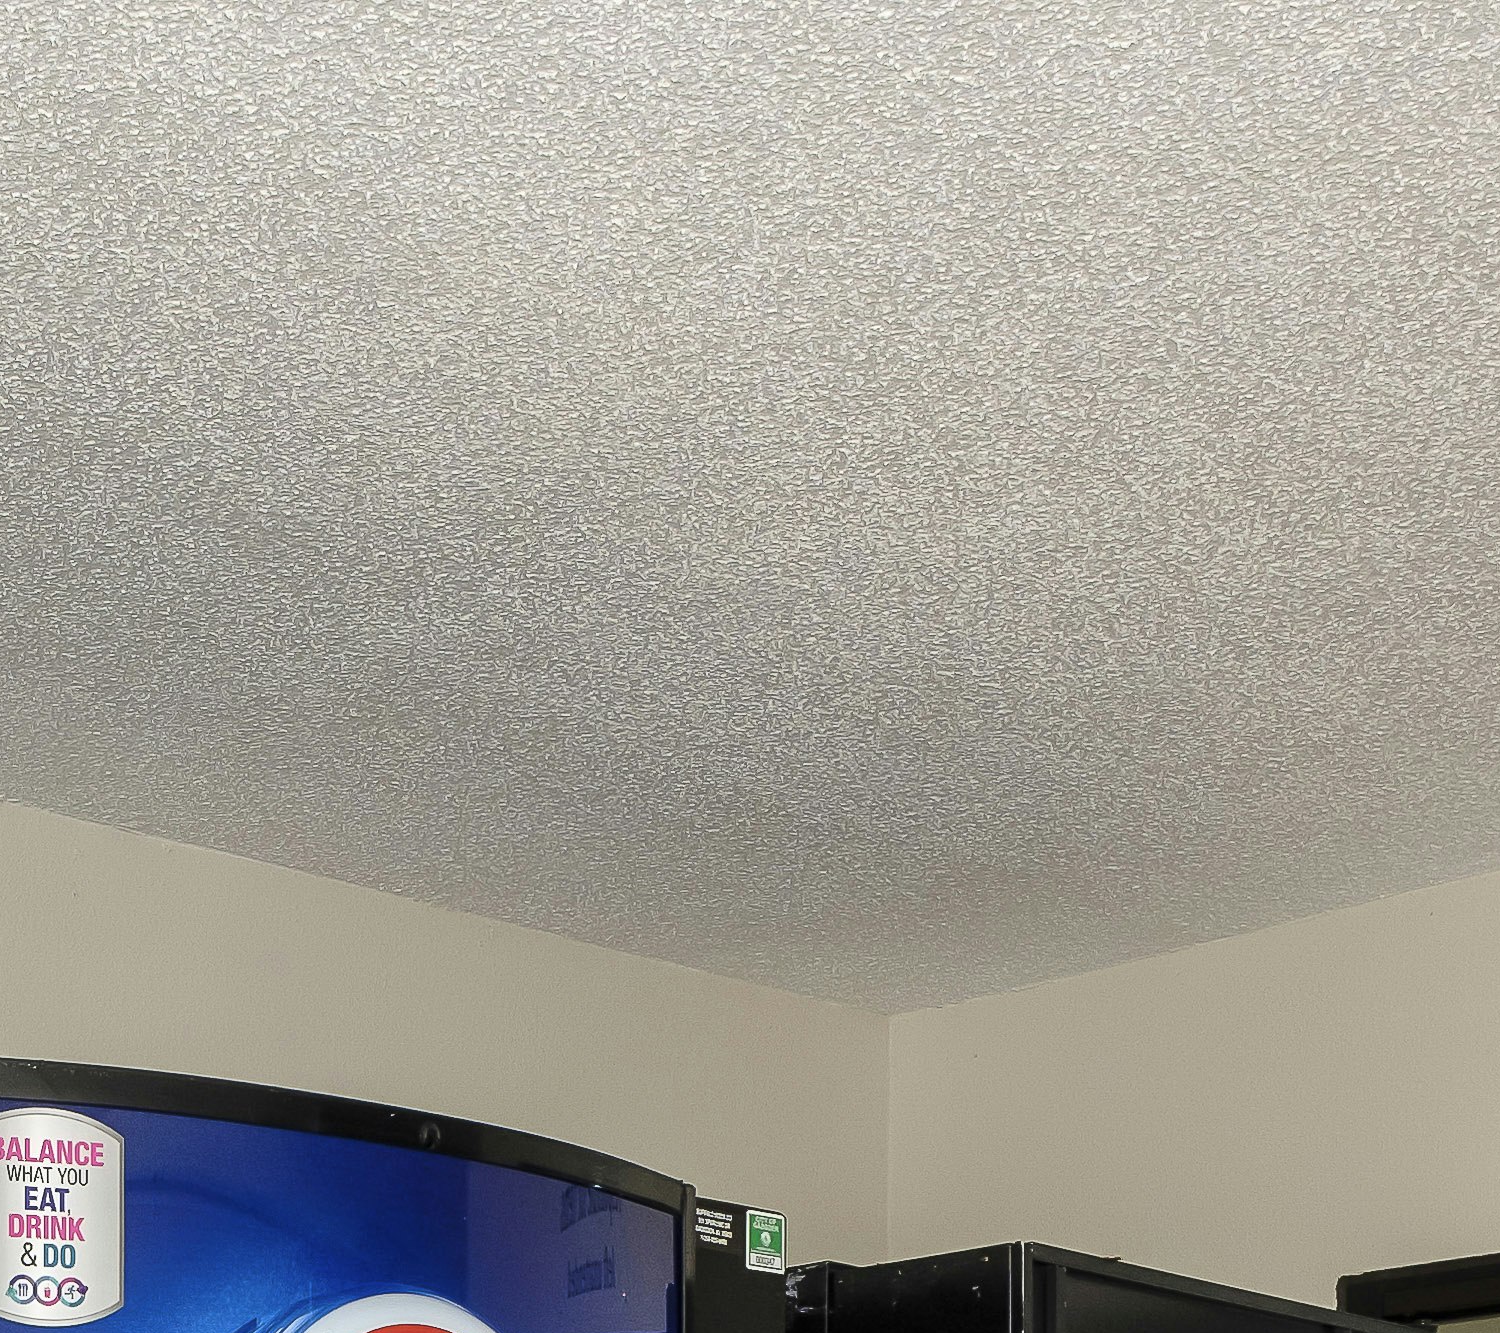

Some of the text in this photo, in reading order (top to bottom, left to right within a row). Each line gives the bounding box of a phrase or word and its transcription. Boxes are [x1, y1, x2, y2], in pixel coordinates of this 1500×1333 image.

[7, 1164, 89, 1186] WHAT YOU
[24, 1185, 72, 1216] EAT,
[8, 1213, 86, 1242] DRINK
[20, 1241, 77, 1269] & DO
